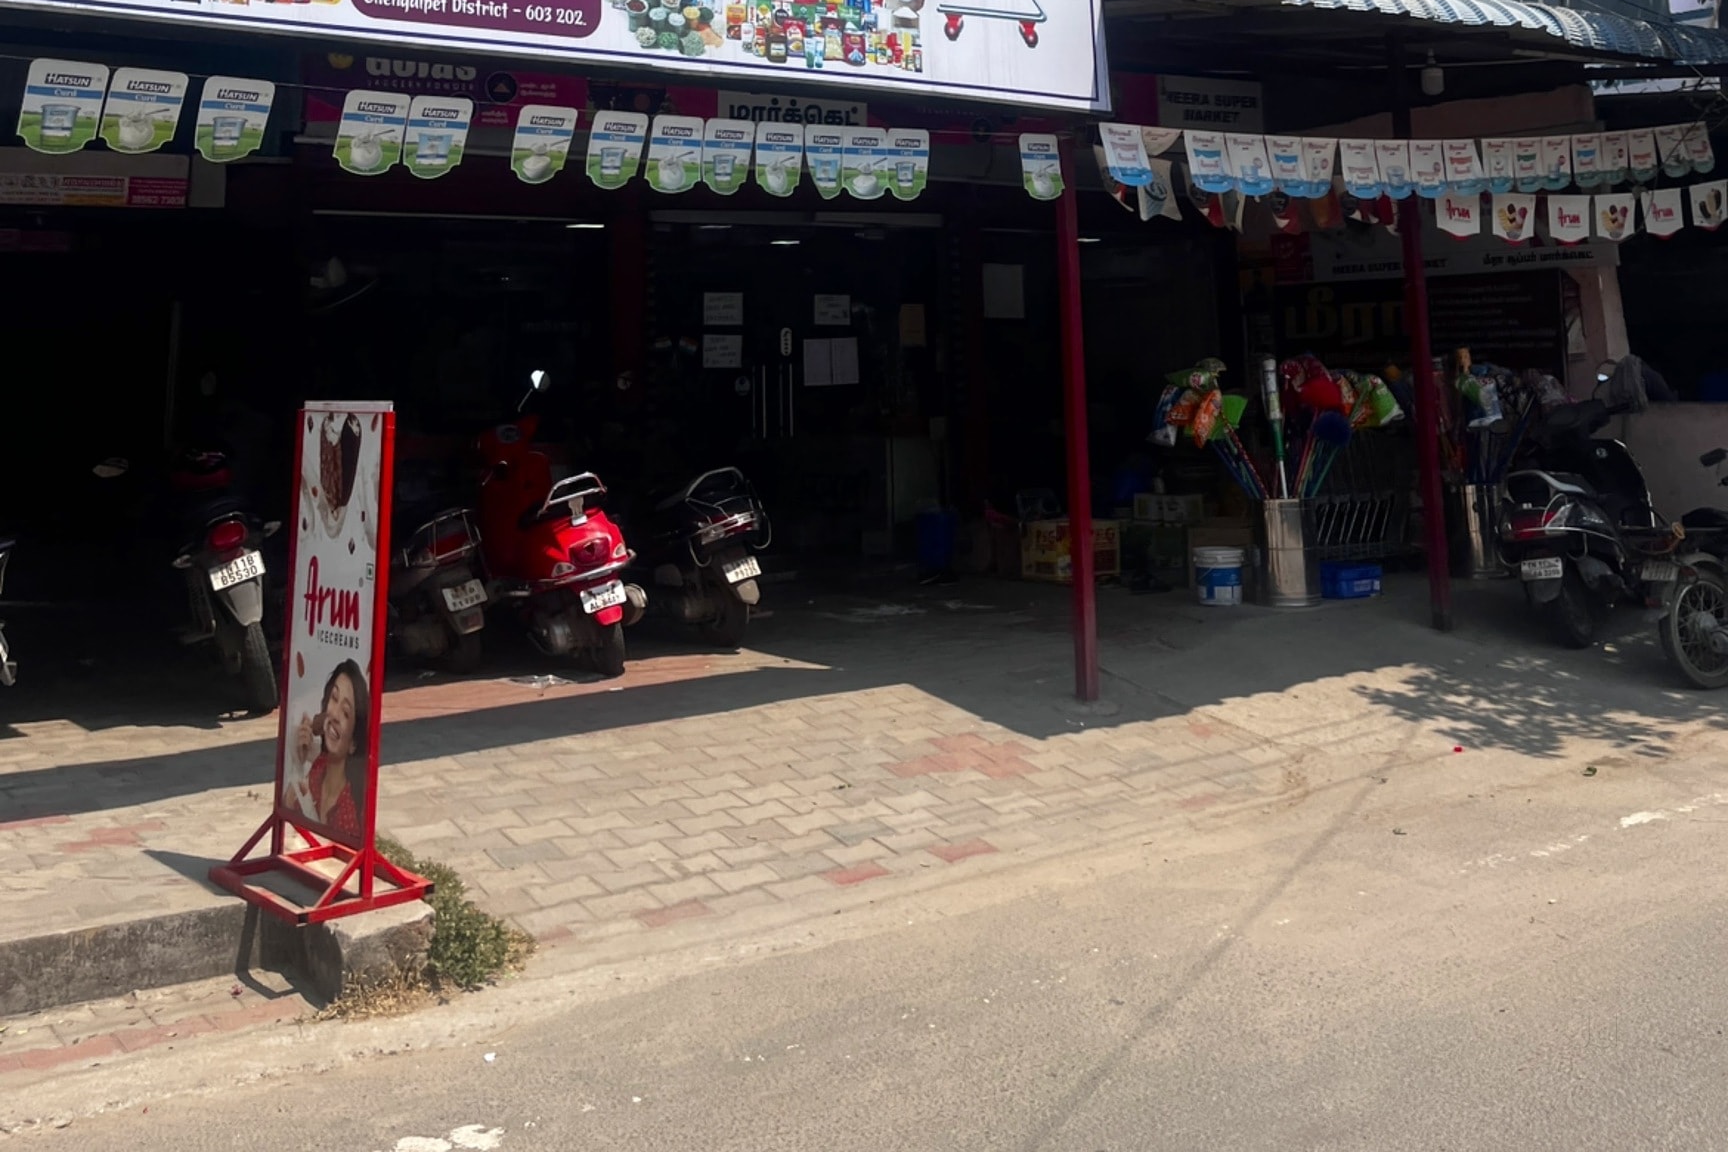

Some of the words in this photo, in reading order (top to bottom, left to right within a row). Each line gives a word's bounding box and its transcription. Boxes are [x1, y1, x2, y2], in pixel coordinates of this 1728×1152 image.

[525, 4, 552, 21] 603
[556, 8, 588, 26] 202.
[46, 73, 91, 87] HATSUN
[127, 80, 171, 93] HATSUN
[54, 88, 77, 97] Curd
[135, 93, 157, 102] Curd
[217, 88, 259, 102] HATSUN
[224, 102, 246, 111] Curd
[358, 101, 397, 115] HATSUN
[422, 107, 459, 119] HATSUN
[728, 97, 861, 127] மார்க்கெட்
[364, 115, 384, 124] Curd
[429, 120, 447, 129] Curd
[304, 555, 359, 637] Arun
[317, 629, 360, 650] ICECREAMS
